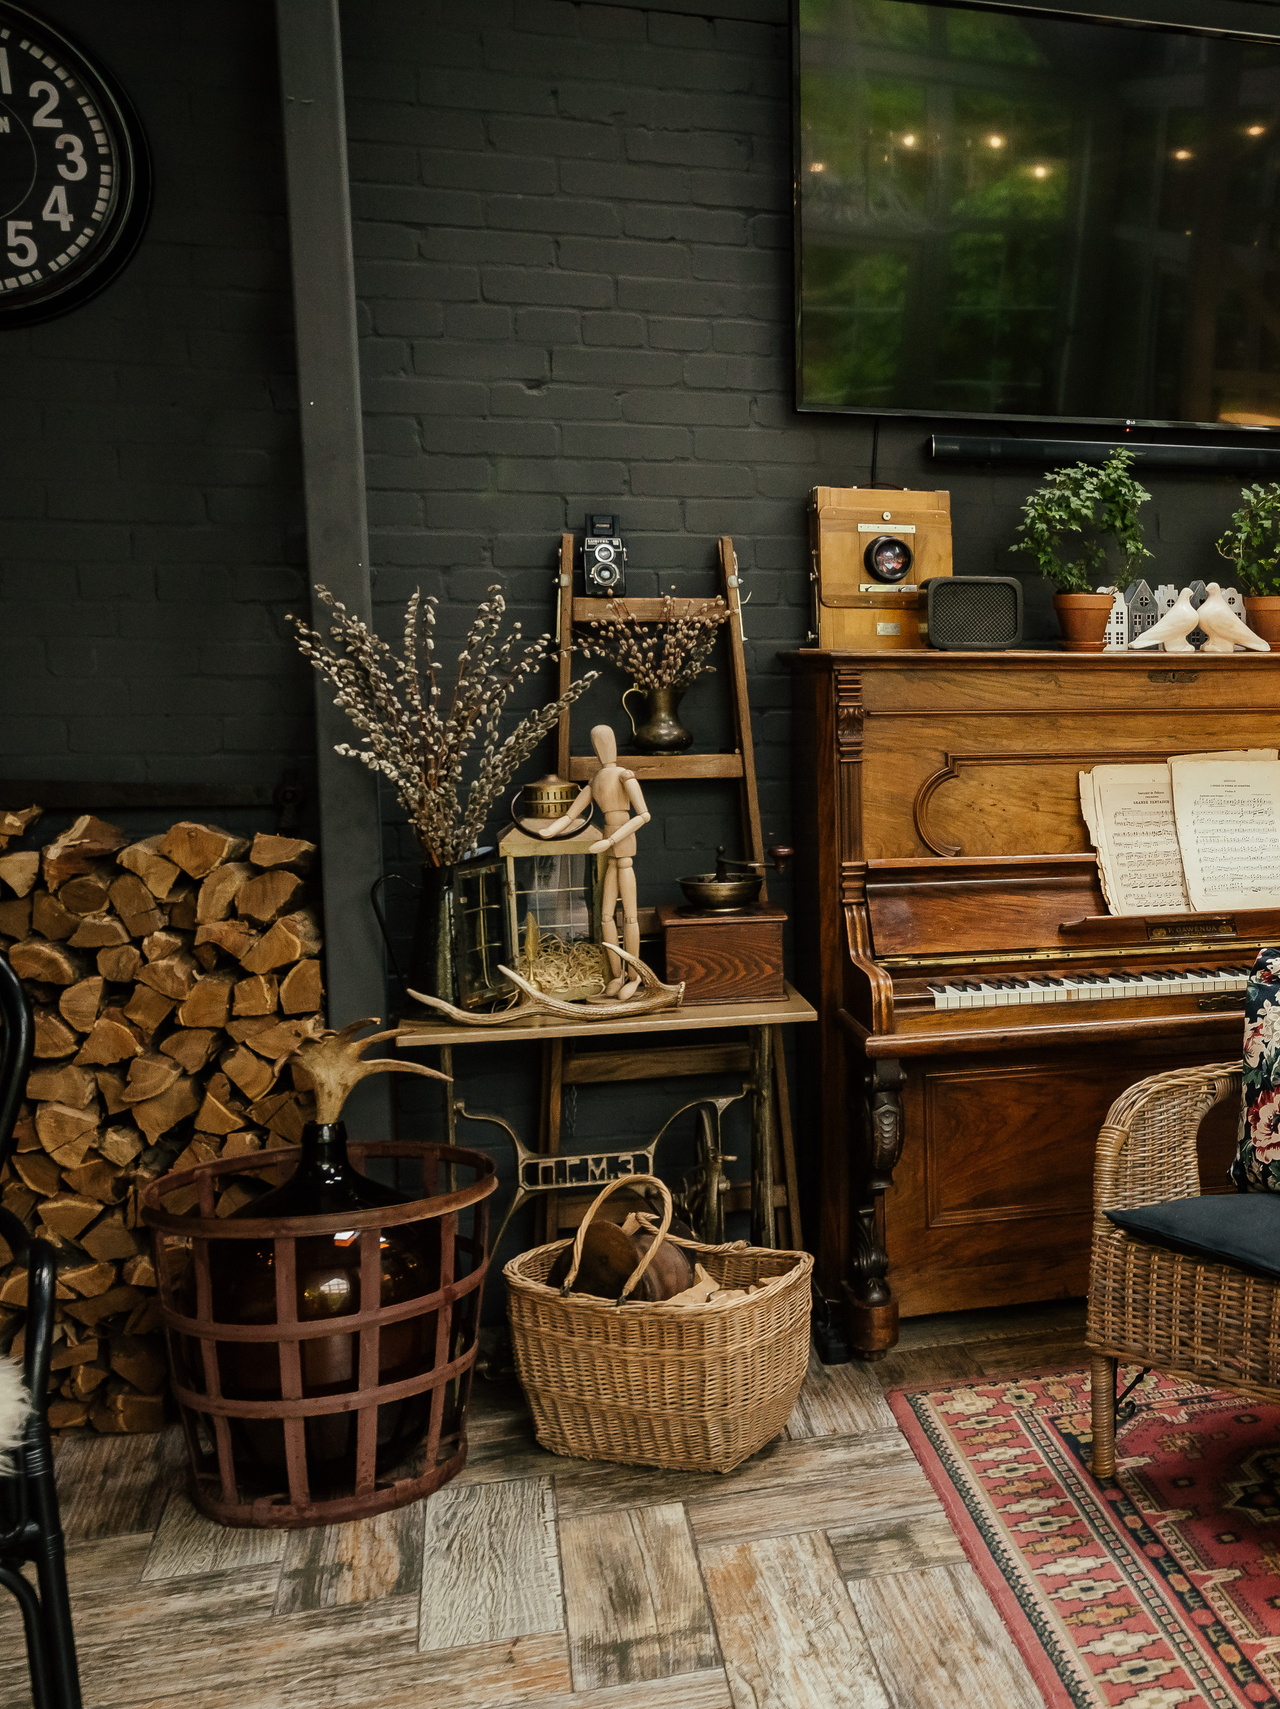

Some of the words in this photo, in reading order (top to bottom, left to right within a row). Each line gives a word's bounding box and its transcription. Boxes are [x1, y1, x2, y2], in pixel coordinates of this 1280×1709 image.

[29, 81, 63, 128] 2
[55, 134, 88, 181] 3
[42, 186, 74, 231] 4
[7, 221, 38, 267] 5
